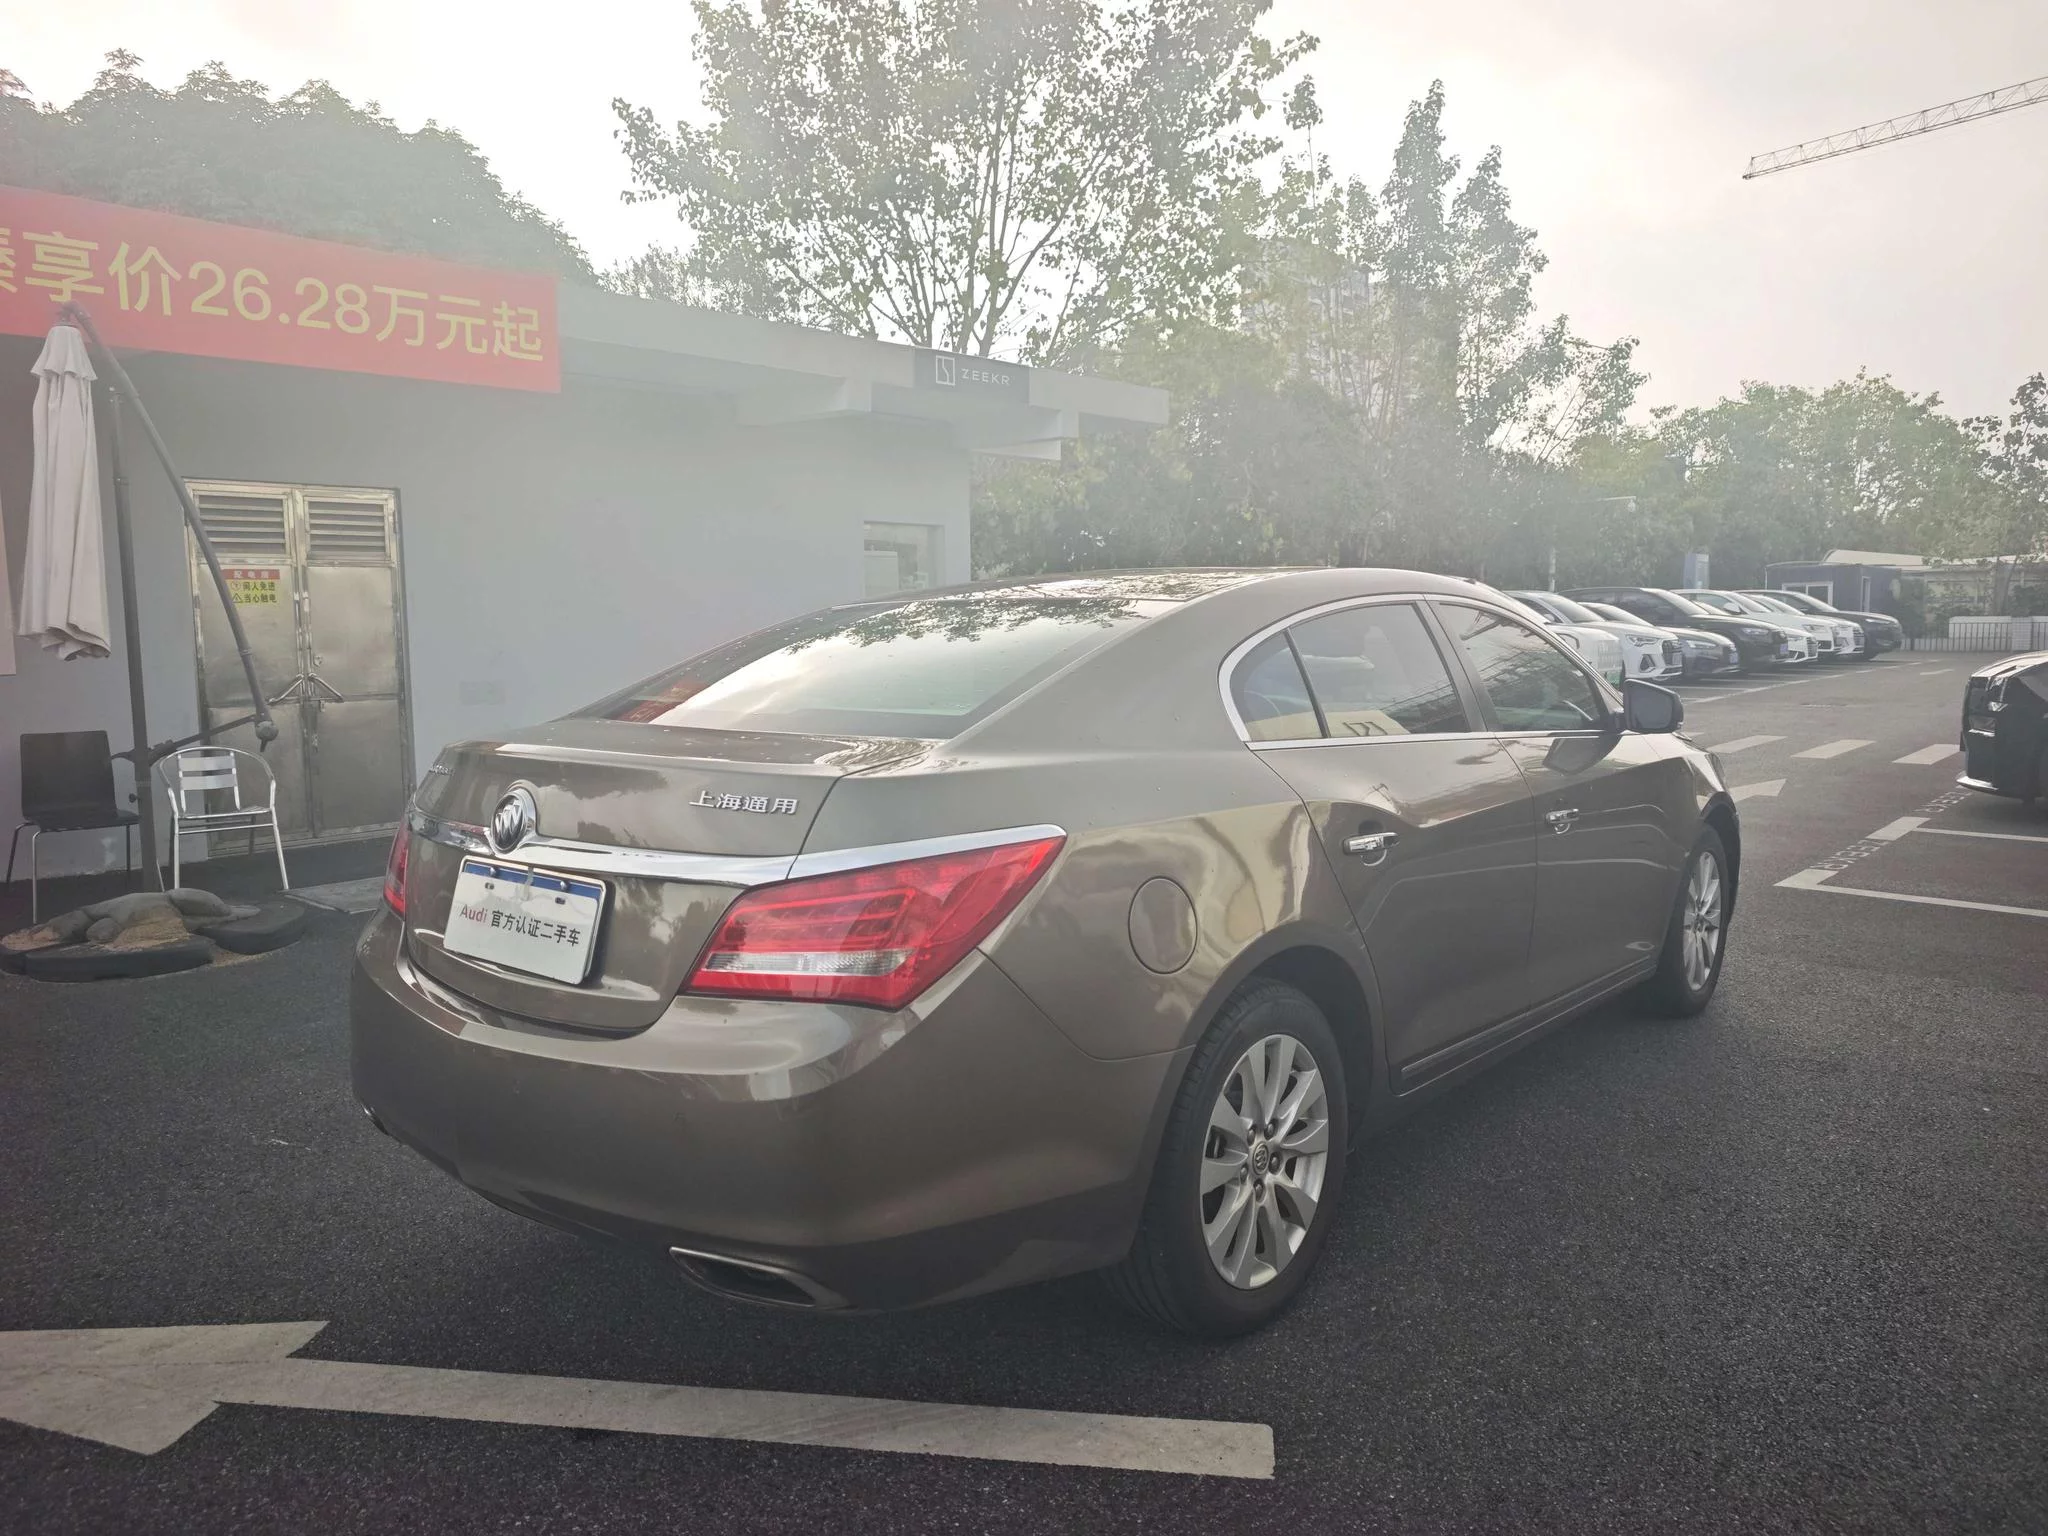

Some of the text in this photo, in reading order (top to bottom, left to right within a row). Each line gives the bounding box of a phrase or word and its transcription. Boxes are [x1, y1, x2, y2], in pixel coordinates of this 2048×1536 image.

[0, 227, 544, 361] 享价26.28万元起
[960, 368, 1011, 385] ZEEKR
[689, 790, 799, 814] 上海通用
[459, 903, 581, 947] Audi 官方认证二手车
